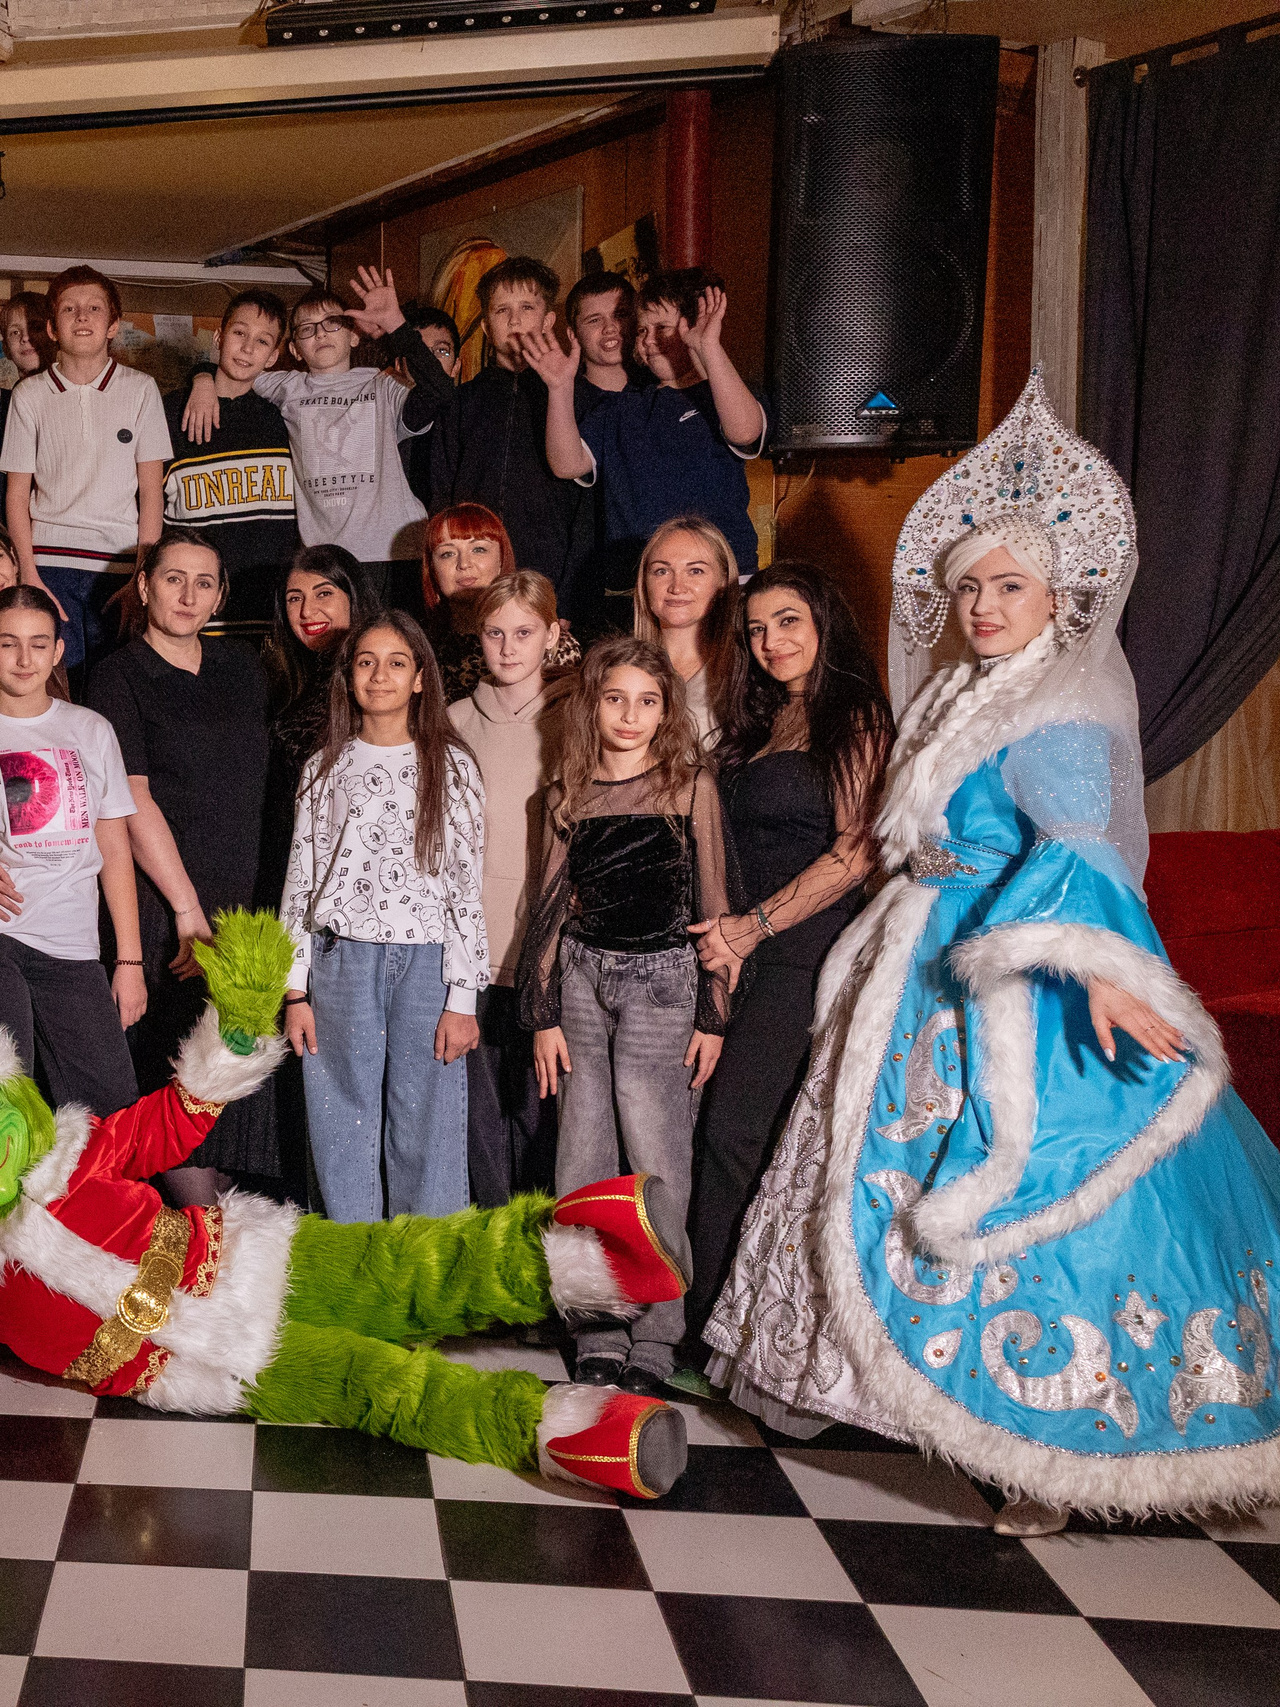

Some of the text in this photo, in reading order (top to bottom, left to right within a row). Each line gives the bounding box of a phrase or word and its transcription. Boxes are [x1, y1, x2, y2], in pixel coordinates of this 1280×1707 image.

[181, 465, 293, 511] UNREAL
[303, 474, 375, 489] FREESTYLE
[69, 750, 89, 828] MEN WALK ON MOON
